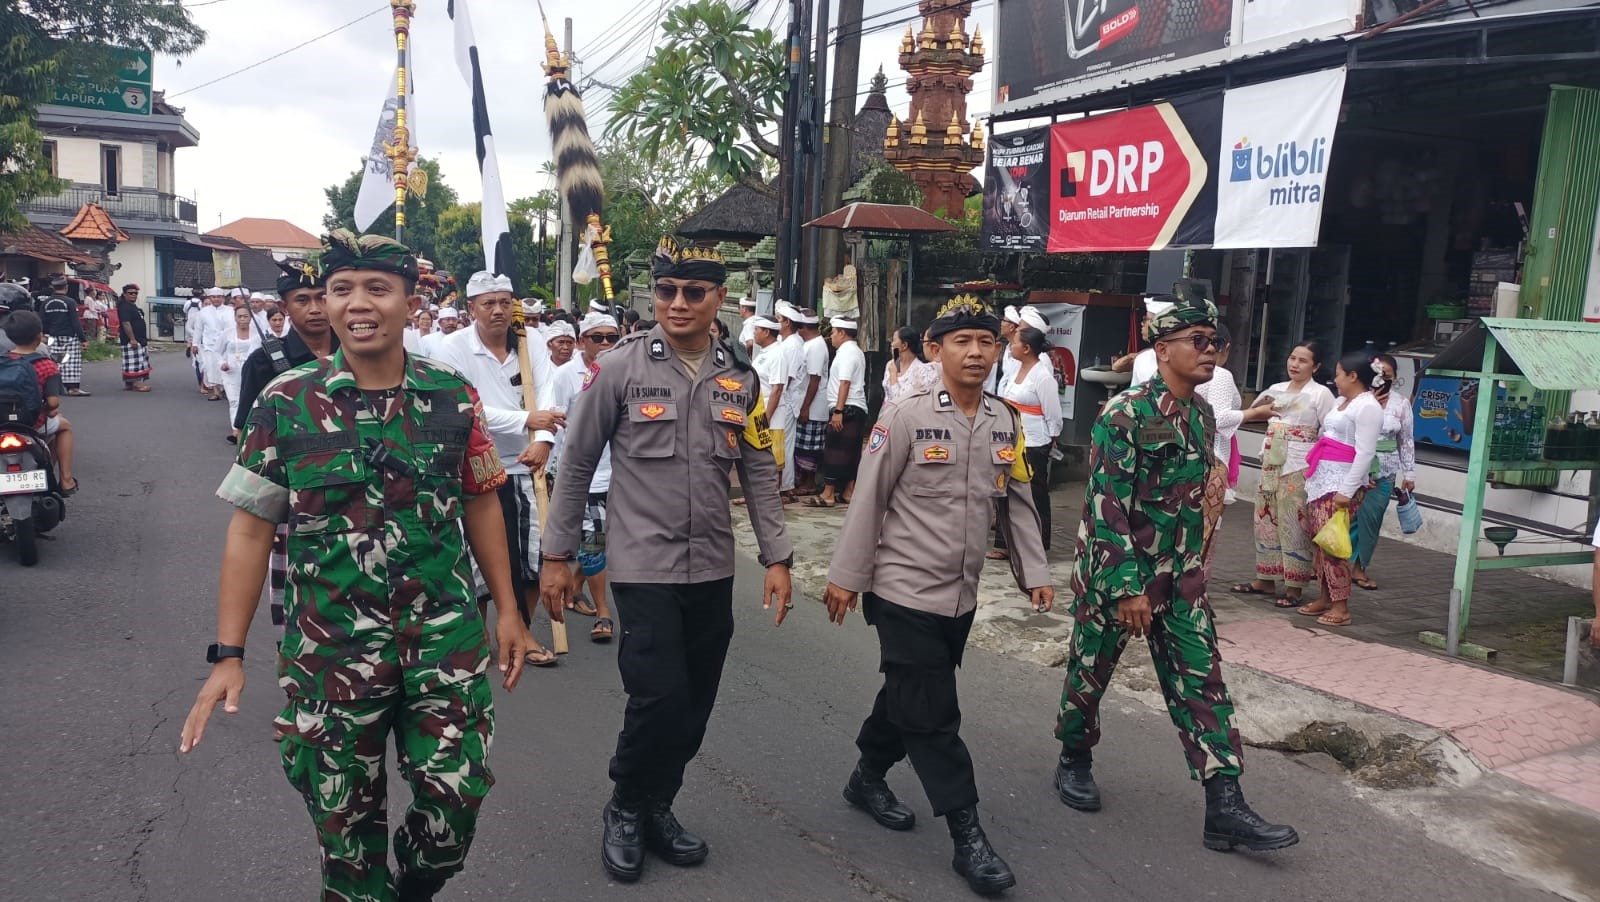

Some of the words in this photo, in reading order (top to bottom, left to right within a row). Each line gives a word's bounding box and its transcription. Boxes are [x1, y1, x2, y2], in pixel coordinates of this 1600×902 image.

[1102, 14, 1129, 34] BOLD
[54, 92, 106, 105] LAPURA
[130, 95, 138, 105] 3
[1257, 137, 1326, 179] blibli
[1090, 141, 1164, 196] DRP
[1269, 180, 1321, 206] mitra
[1059, 209, 1086, 223] Djarum
[1087, 206, 1108, 219] Retail
[1109, 203, 1160, 218] Partnership
[713, 391, 746, 406] POLRI
[1421, 391, 1450, 401] CRISPY
[915, 429, 952, 441] DEWA
[6, 474, 28, 482] 3150
[33, 472, 44, 480] RC
